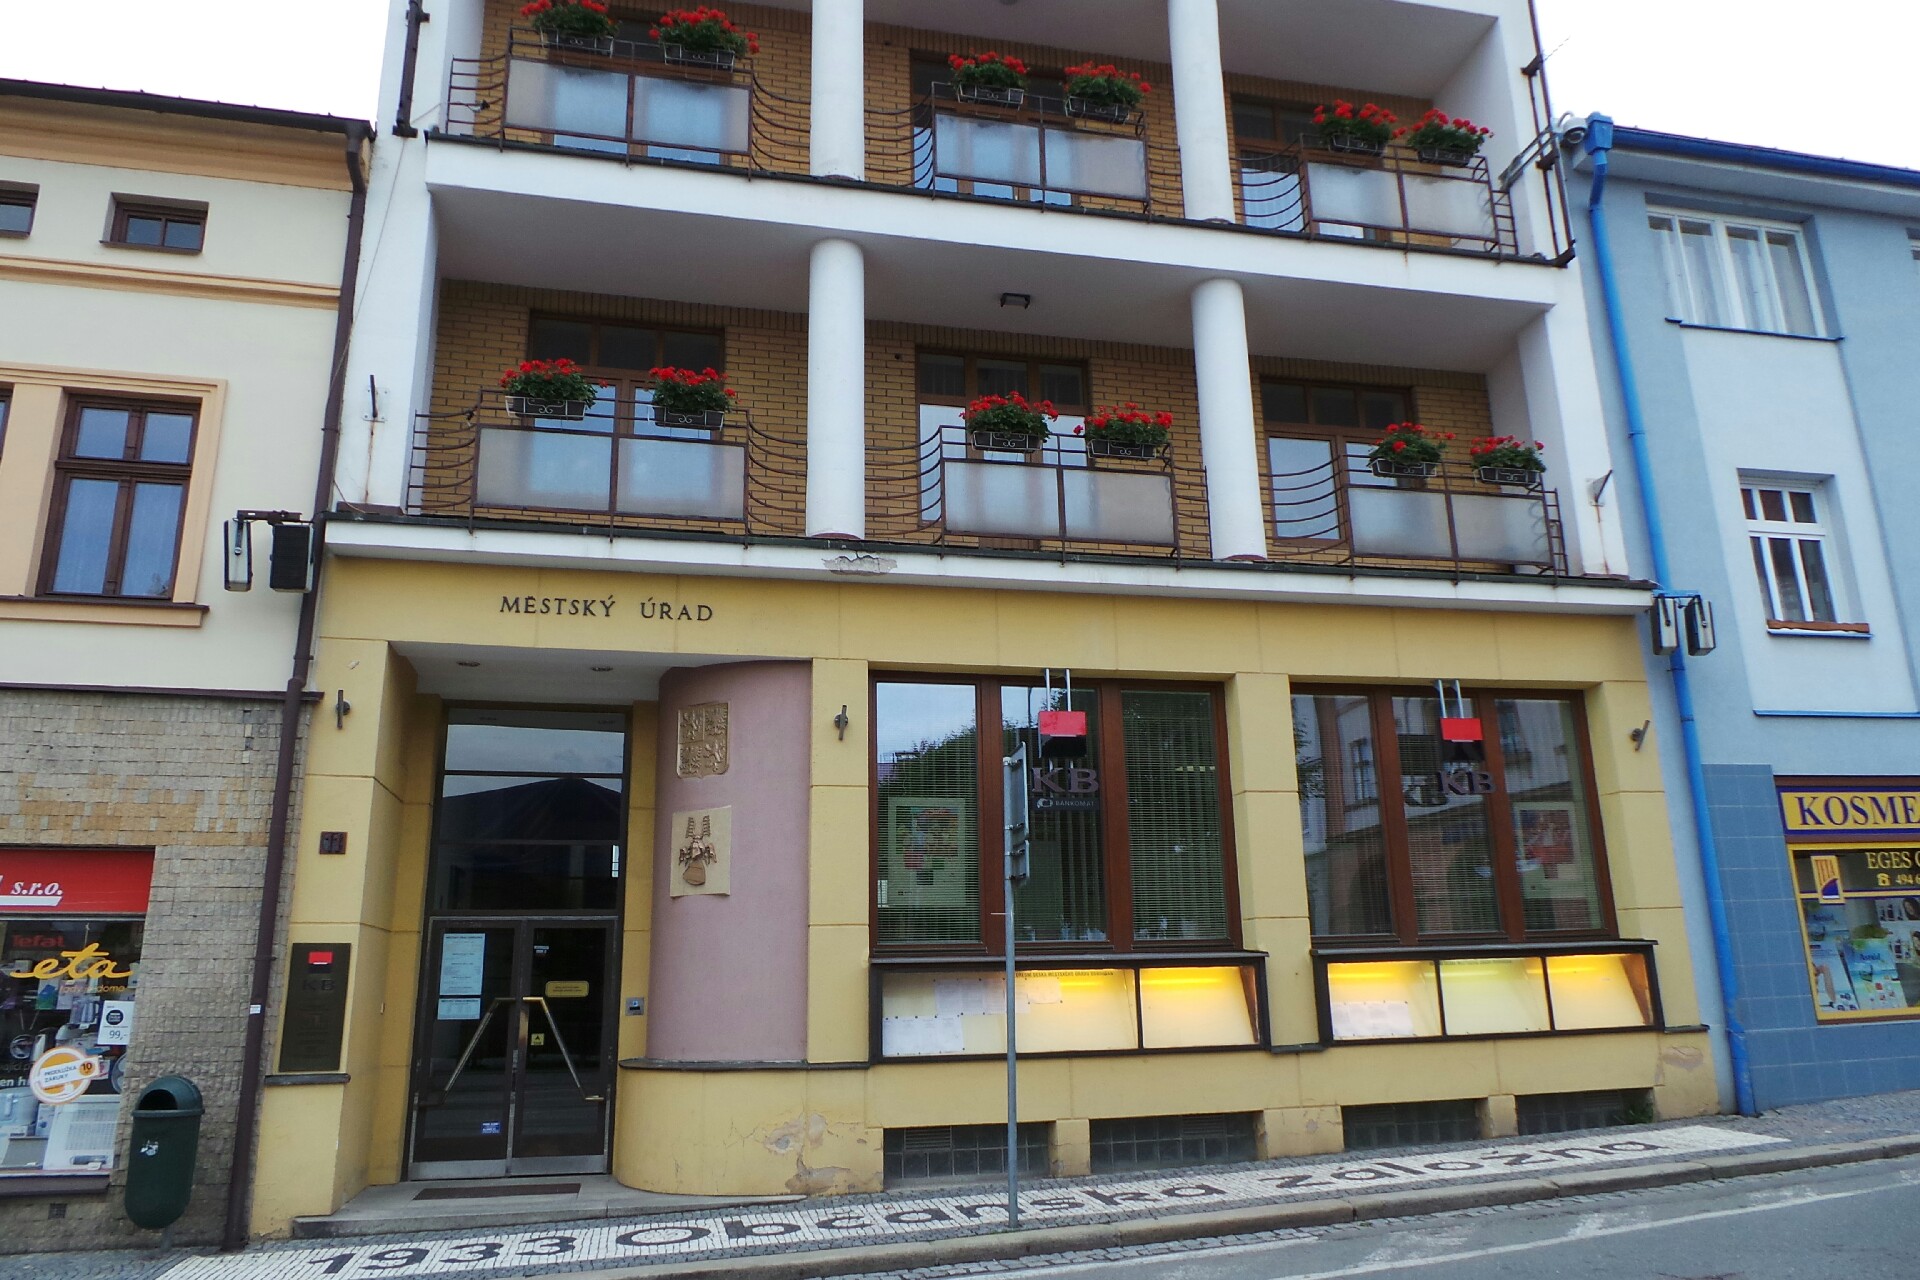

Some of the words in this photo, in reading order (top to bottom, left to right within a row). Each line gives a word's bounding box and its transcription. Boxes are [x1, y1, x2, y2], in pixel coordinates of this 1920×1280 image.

[1031, 767, 1099, 793] KB
[1438, 770, 1495, 795] KB
[1865, 850, 1912, 869] EGES
[10, 881, 63, 896] s.r.o.
[9, 942, 133, 980] eta
[81, 1062, 93, 1071] 10
[309, 1235, 577, 1275] 1933
